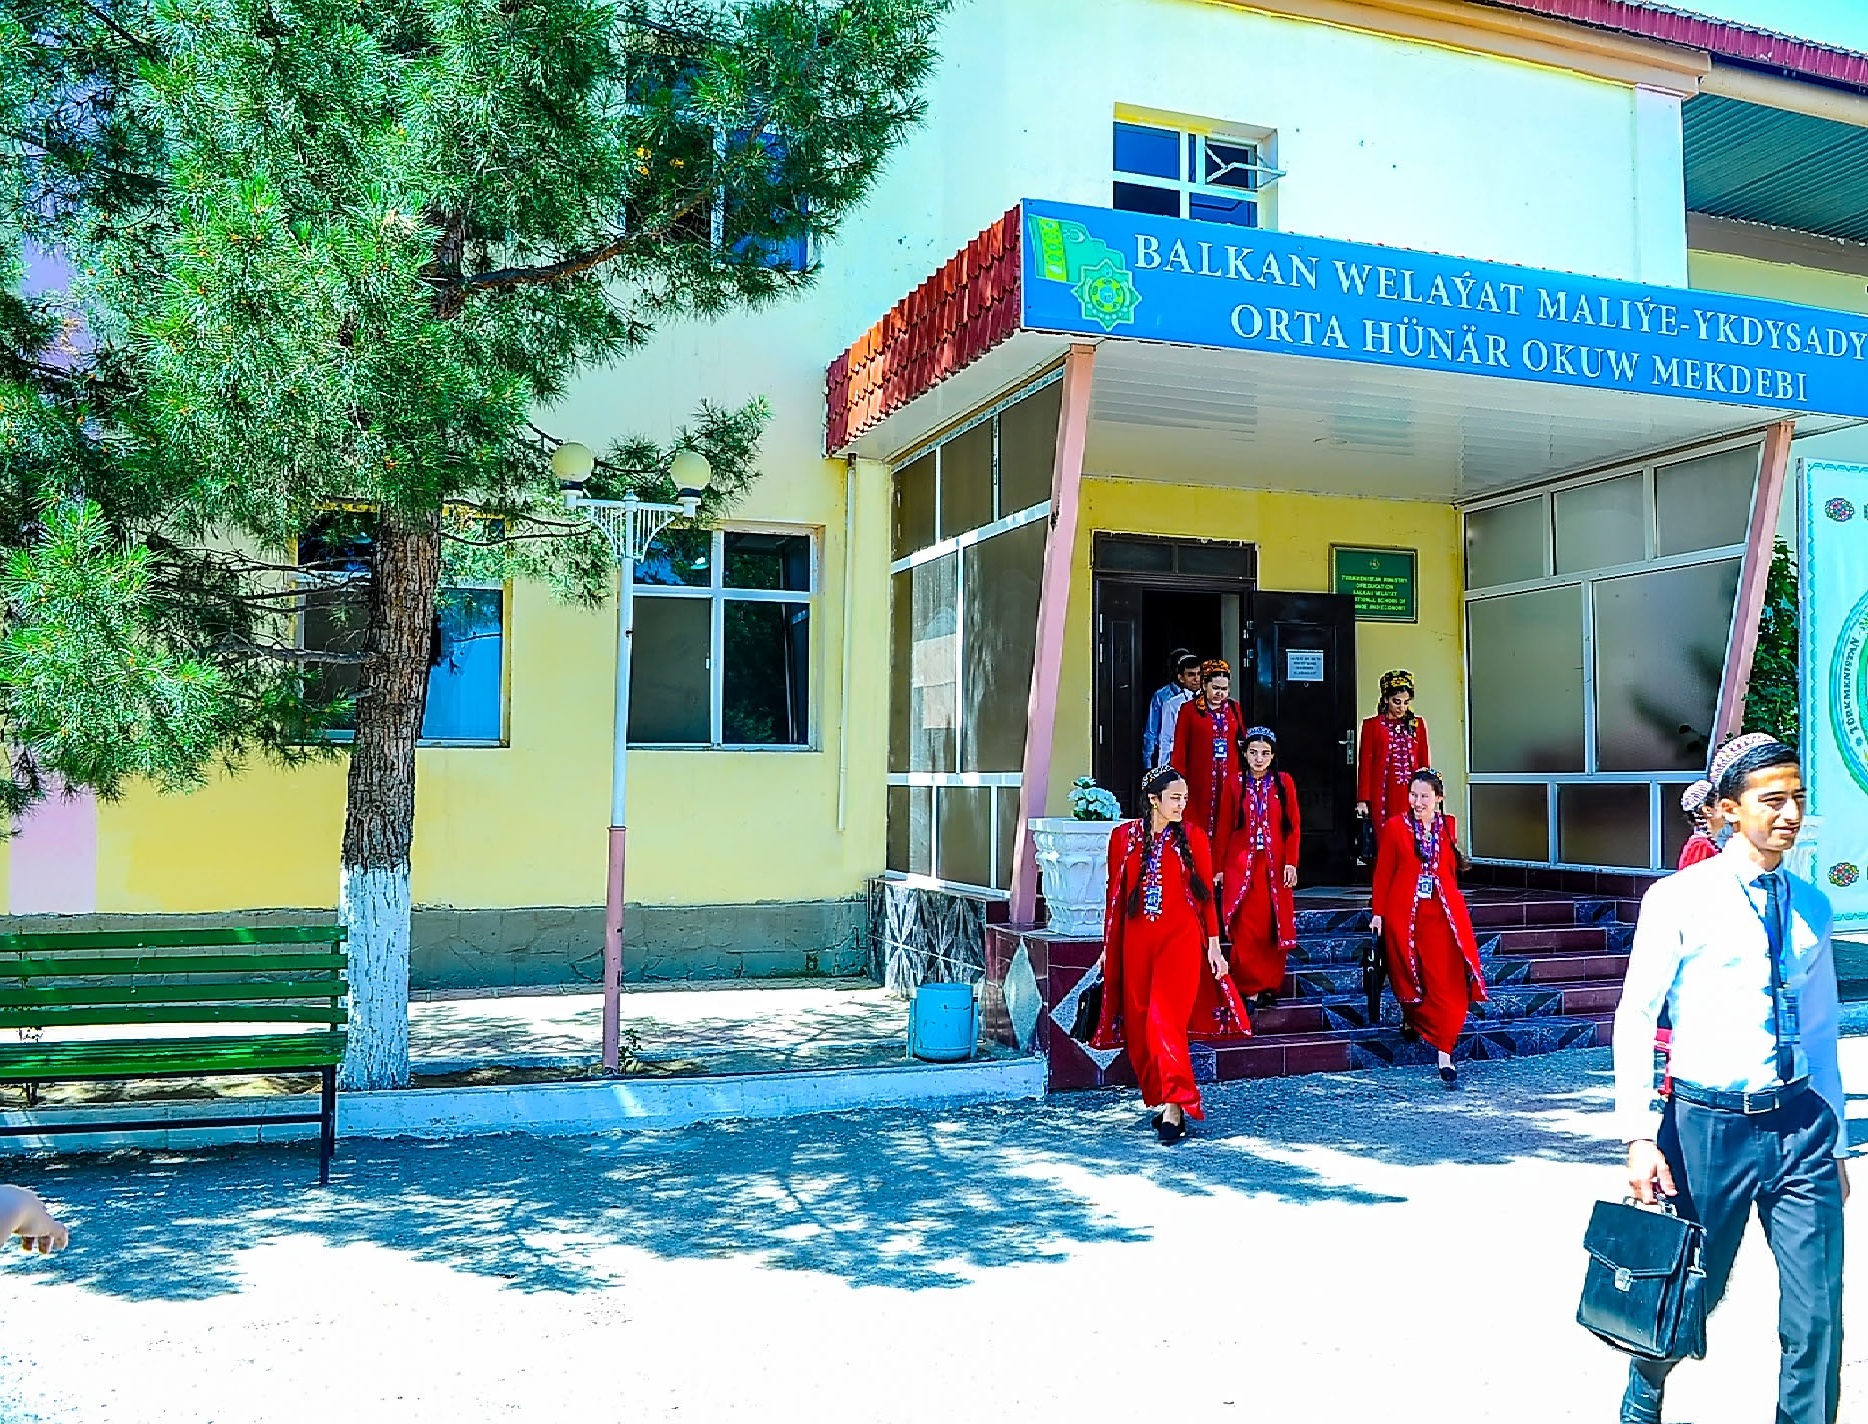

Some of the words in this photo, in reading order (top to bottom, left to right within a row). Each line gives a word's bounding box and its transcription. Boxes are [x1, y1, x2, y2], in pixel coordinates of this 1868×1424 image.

[1134, 234, 1320, 290] BALKAN
[1331, 260, 1524, 315] WELAÝAT
[1230, 304, 1350, 353] ORTA
[1362, 315, 1511, 368] HÜNÄR
[1522, 339, 1640, 383] OKUW
[1651, 355, 1808, 402] MEKDEBI
